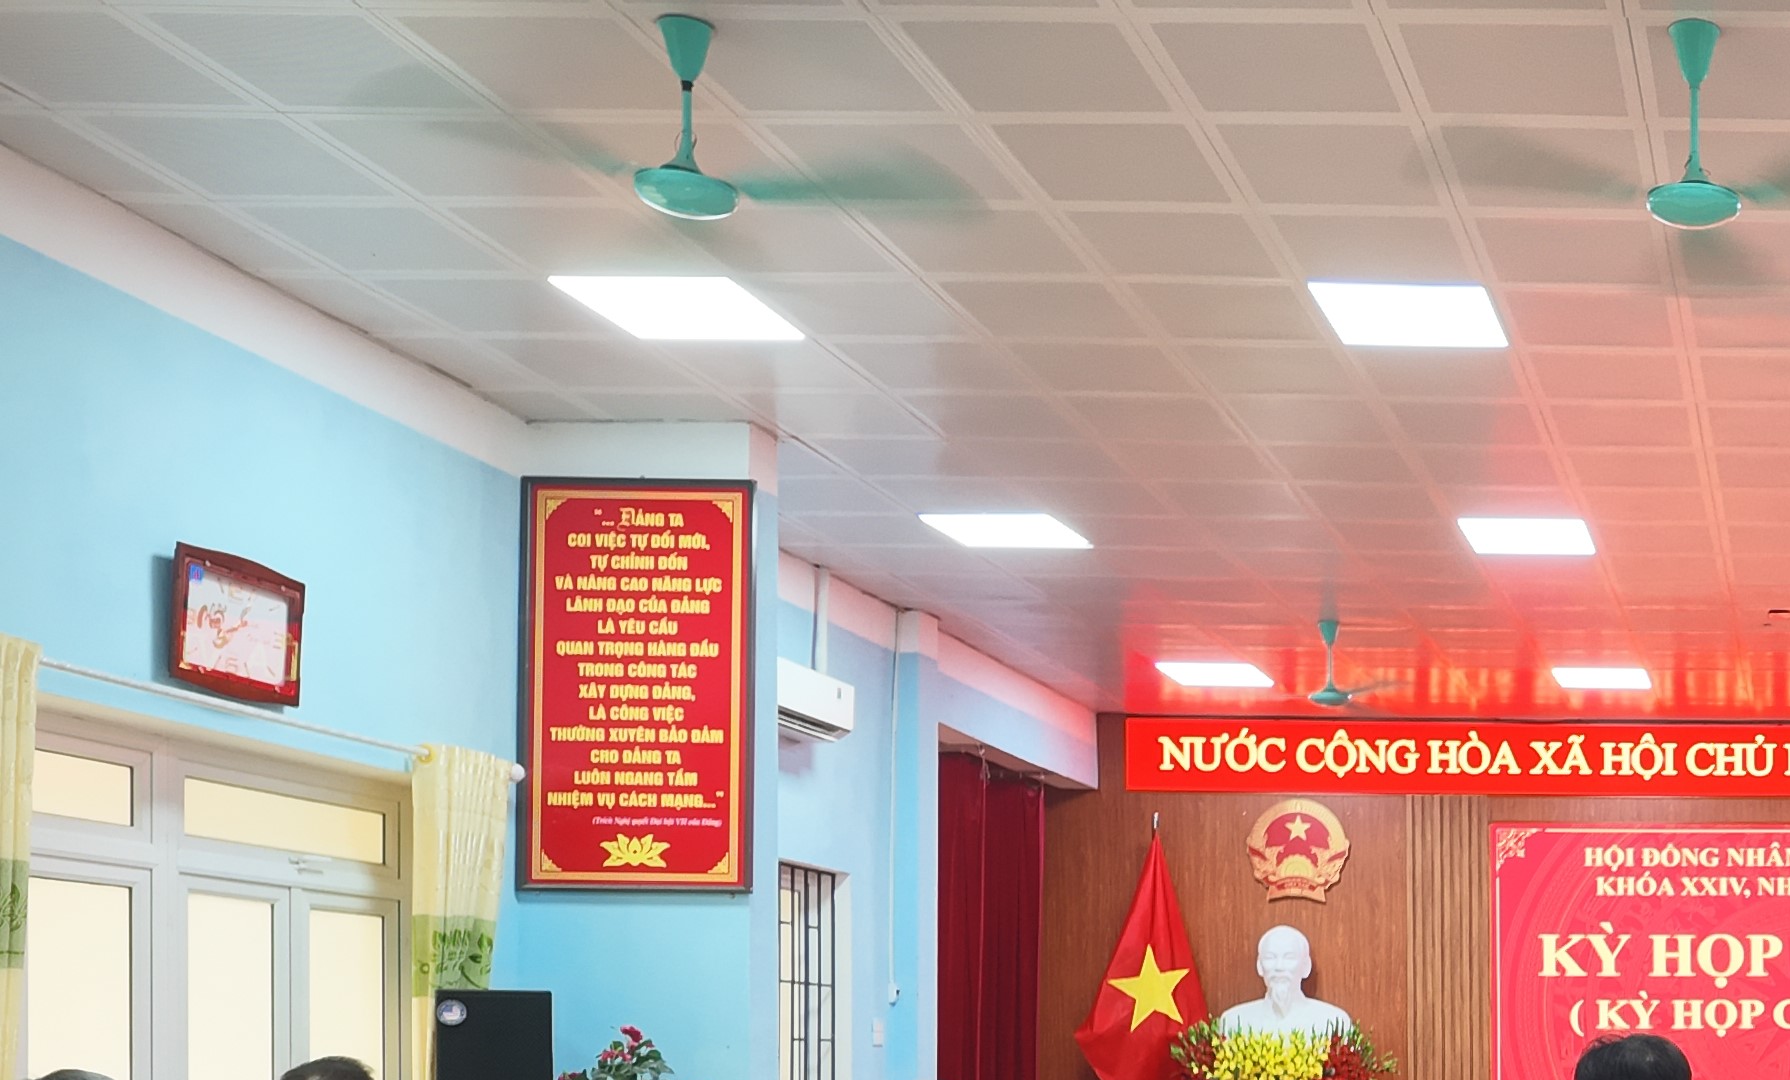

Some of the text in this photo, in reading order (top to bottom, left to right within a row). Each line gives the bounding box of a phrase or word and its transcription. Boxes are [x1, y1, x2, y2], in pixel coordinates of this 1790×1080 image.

[617, 507, 684, 531] ĐẢNG TA
[568, 533, 591, 547] COI
[595, 531, 626, 550] VIỆC
[630, 533, 649, 551] TỰ
[679, 532, 710, 550] MỚI,
[590, 554, 609, 572] TỰ
[658, 552, 688, 570] ĐỐN
[555, 573, 722, 595] VÀ NÂNG CAO NĂNG LỰC
[566, 595, 710, 615] LÃNH ĐẠO CỦA ĐẢNG
[598, 617, 678, 635] LÀ YÊU CẦU
[556, 639, 719, 658] QUAN TRỌNG HÀNG ĐẦU
[577, 661, 697, 678] TRONG CÔNG TÁC
[578, 681, 696, 701] XÂY DỰNG ĐẢNG,
[589, 704, 684, 724] LÀ CÔNG VIỆC
[550, 724, 724, 743] THƯỜNG XUYÊN BẢO ĐẢM
[590, 746, 681, 764] CHO ĐẢNG TA
[1158, 729, 1287, 774] NƯỚC
[1295, 729, 1418, 778] CỘNG
[1427, 730, 1522, 775] HÒA
[1528, 733, 1592, 776] XÃ
[1600, 732, 1678, 780] HỘI
[1685, 734, 1775, 777] CHỦ
[574, 768, 697, 786] LUÔN NGANG TẦM
[547, 790, 593, 809] NHIỆM
[597, 793, 615, 809] VỤ
[619, 791, 657, 807] CÁCH
[1584, 844, 1635, 873] HỘI
[1642, 841, 1720, 868] ĐỒNG
[1597, 874, 1675, 897] KHÓA
[1680, 877, 1751, 899] XXIV,
[1538, 921, 1633, 977] KỲ
[1649, 932, 1785, 989] HỌP
[1596, 992, 1664, 1031] KỲ
[1672, 998, 1766, 1037] HỌP
